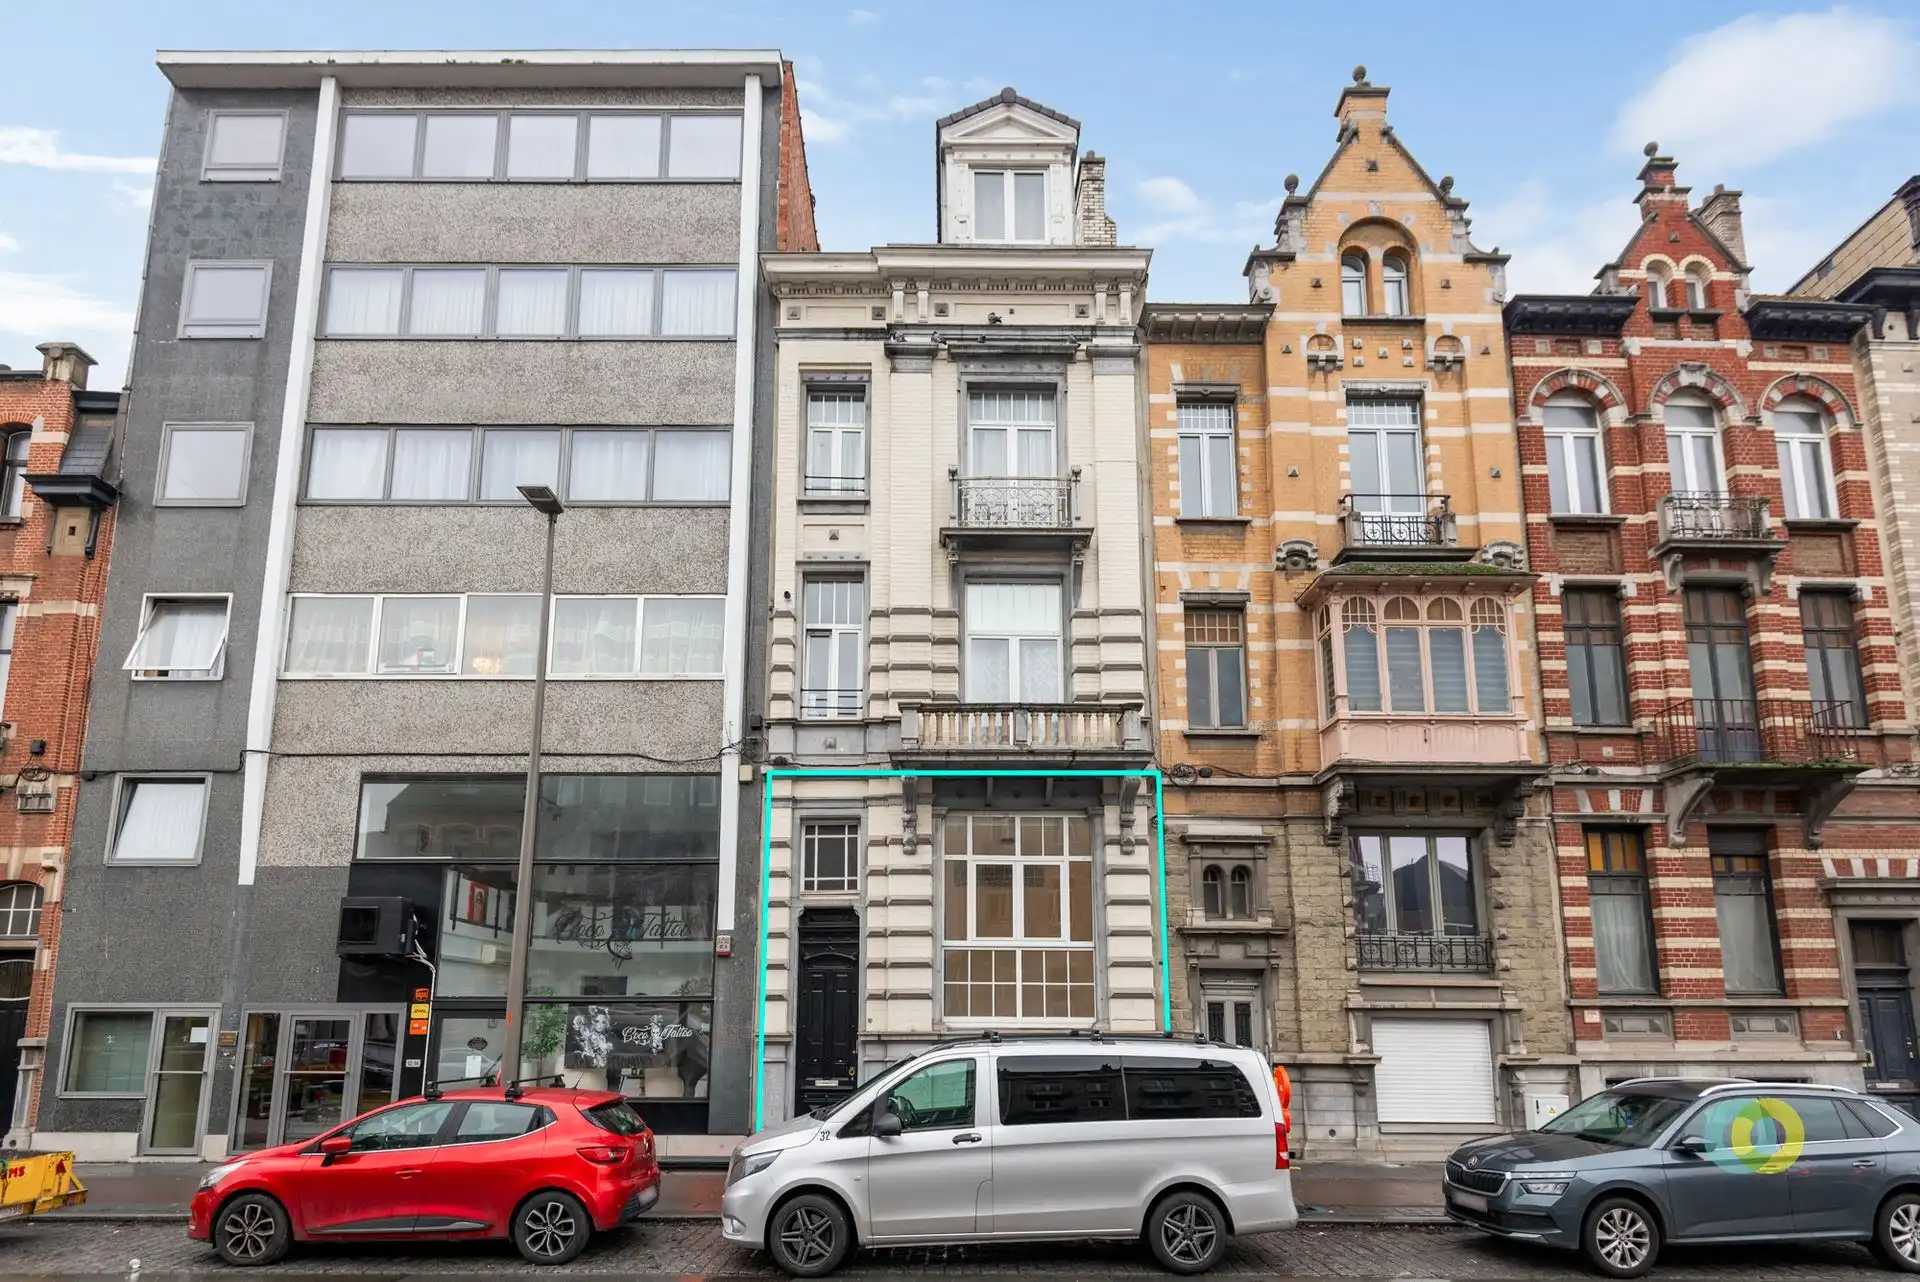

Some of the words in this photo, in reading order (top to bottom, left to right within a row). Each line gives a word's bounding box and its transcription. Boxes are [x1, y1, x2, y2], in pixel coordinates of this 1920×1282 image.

[622, 1026, 649, 1043] Coco
[660, 1024, 693, 1040] Tattoo
[820, 1130, 831, 1141] 32
